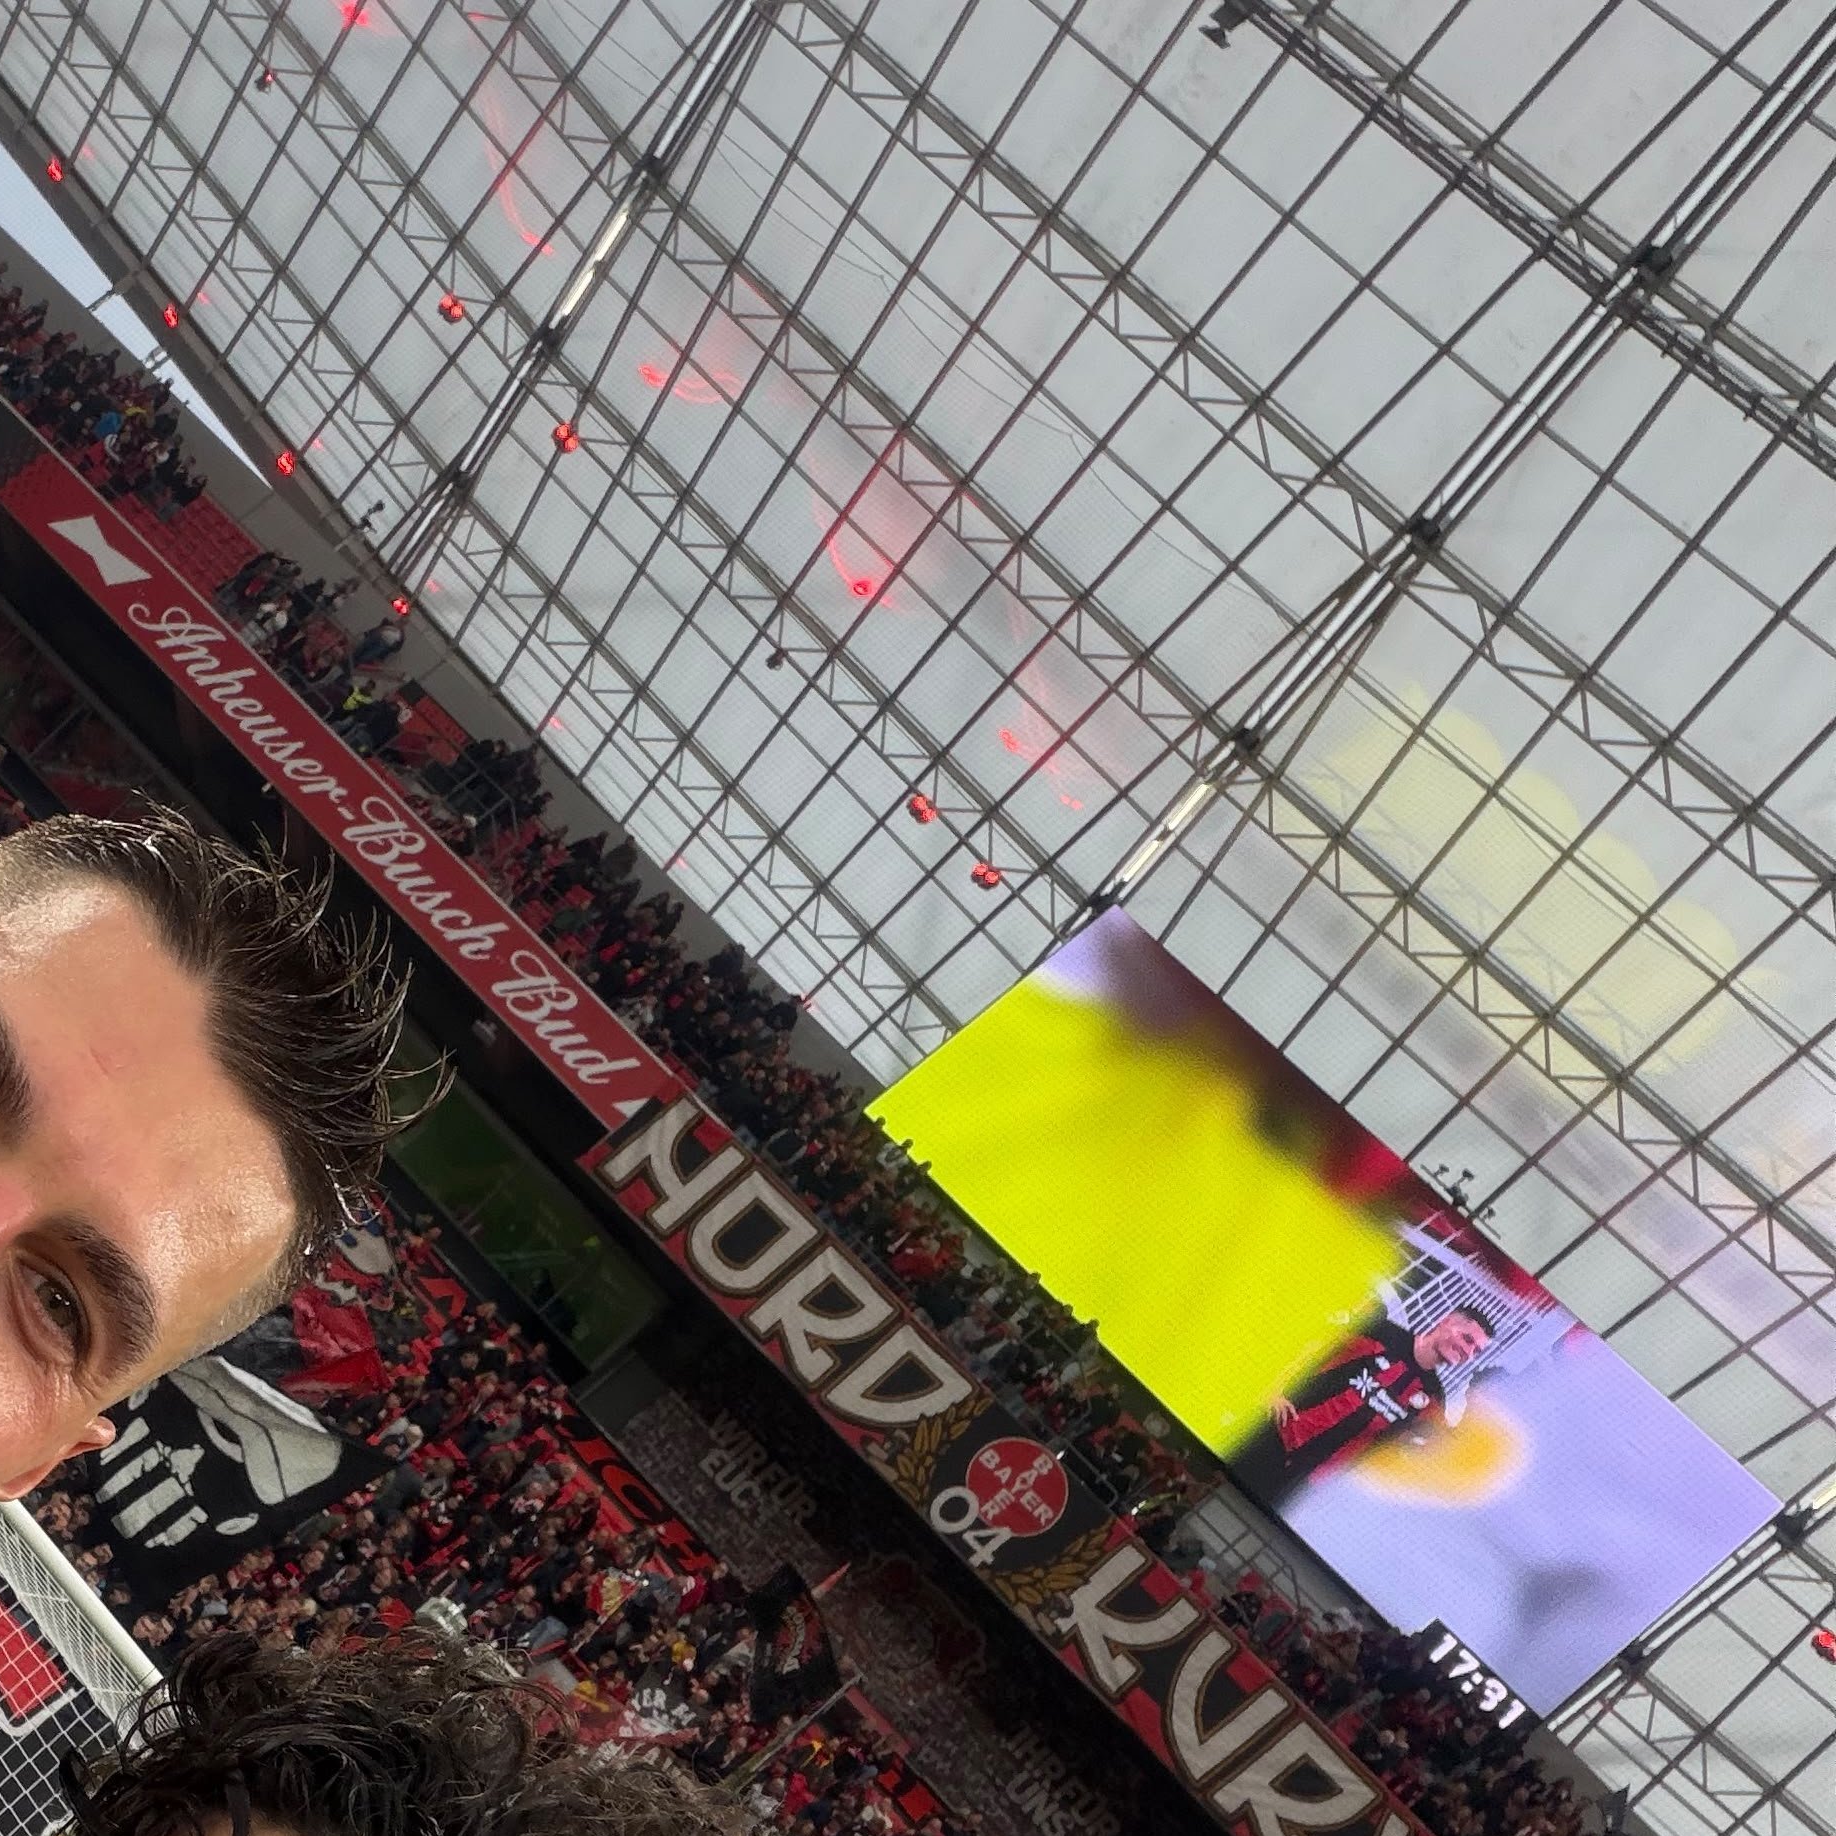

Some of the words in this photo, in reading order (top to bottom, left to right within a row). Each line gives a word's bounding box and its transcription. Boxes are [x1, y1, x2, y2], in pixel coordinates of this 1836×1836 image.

[128, 601, 496, 963] Anheuser-Busch
[491, 949, 643, 1087] Bud
[598, 1097, 979, 1428] NORD
[930, 1486, 1013, 1567] 04
[697, 1447, 773, 1528] EUC
[1429, 1633, 1526, 1729] 17:31
